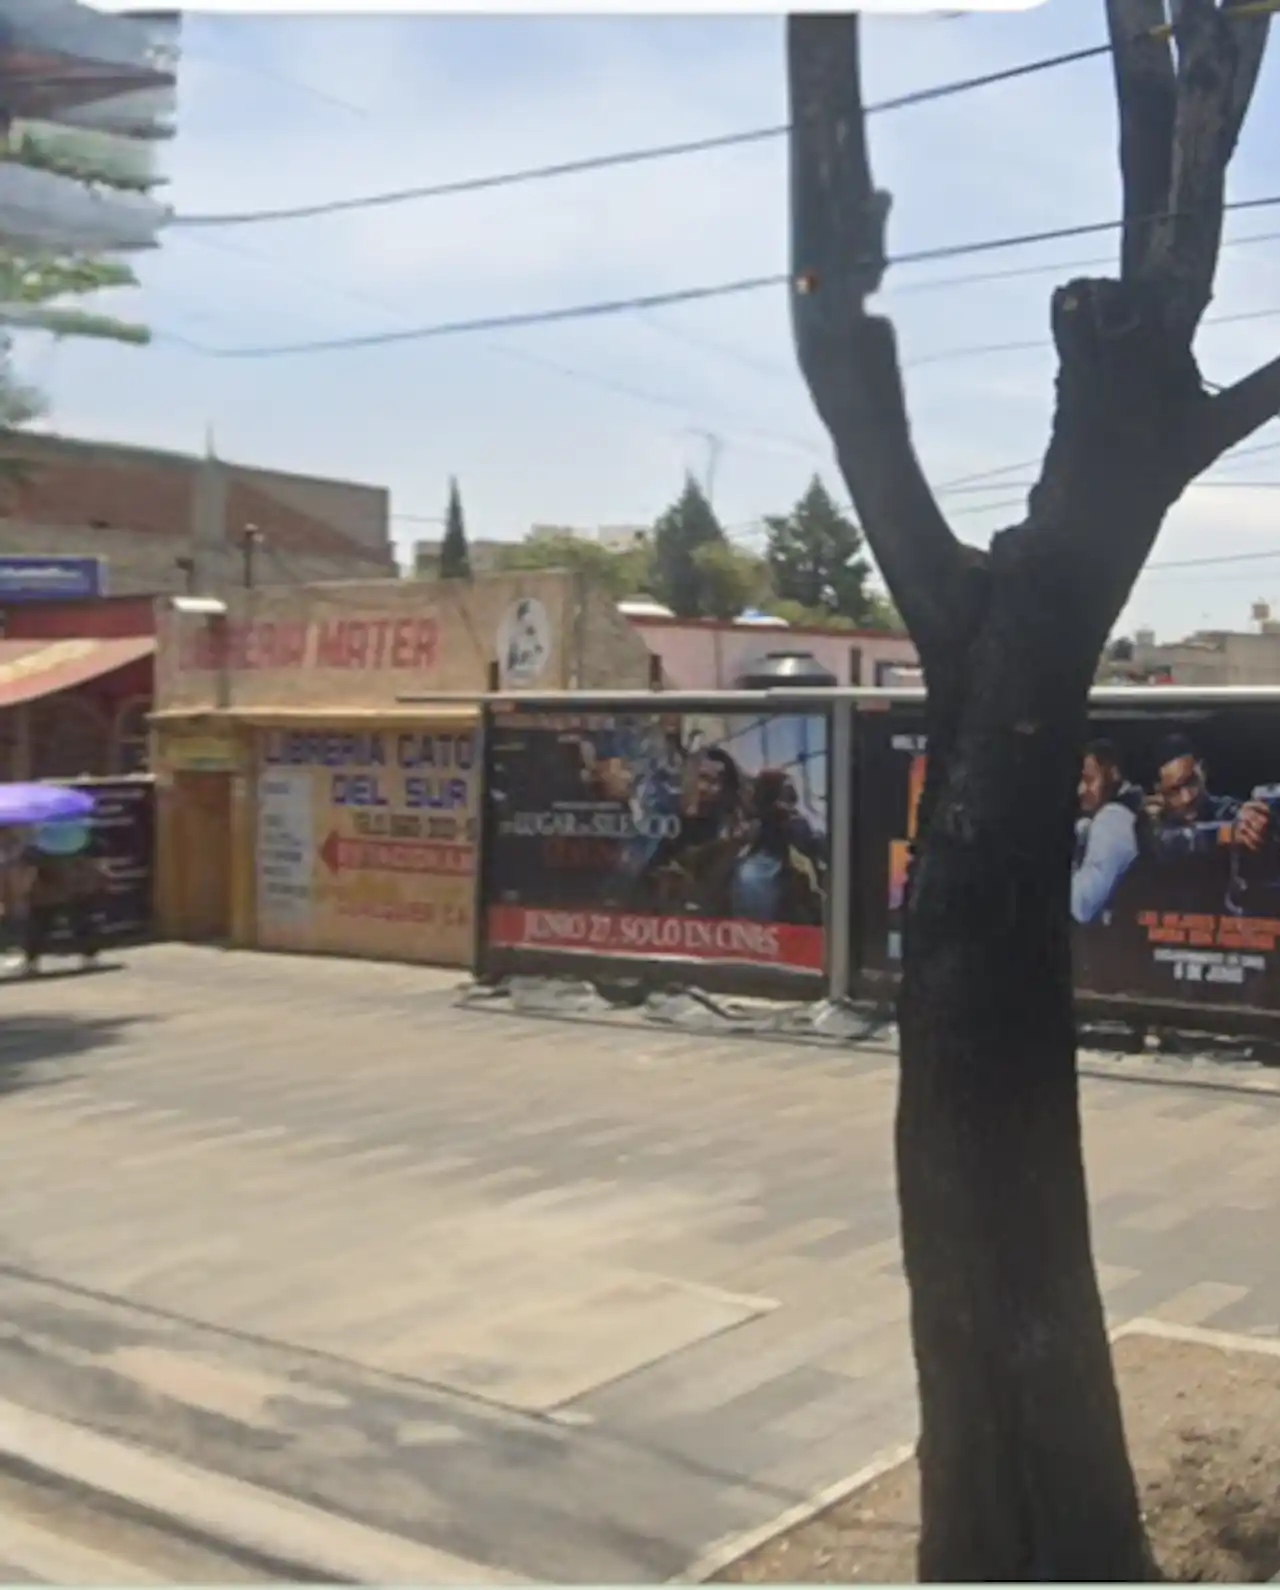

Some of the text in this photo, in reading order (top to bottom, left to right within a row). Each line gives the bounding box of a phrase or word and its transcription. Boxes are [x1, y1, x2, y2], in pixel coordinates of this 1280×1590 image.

[332, 774, 468, 810] DEL SUR
[619, 913, 681, 947] SOLO
[684, 919, 715, 949] EN
[716, 921, 780, 956] CINES
